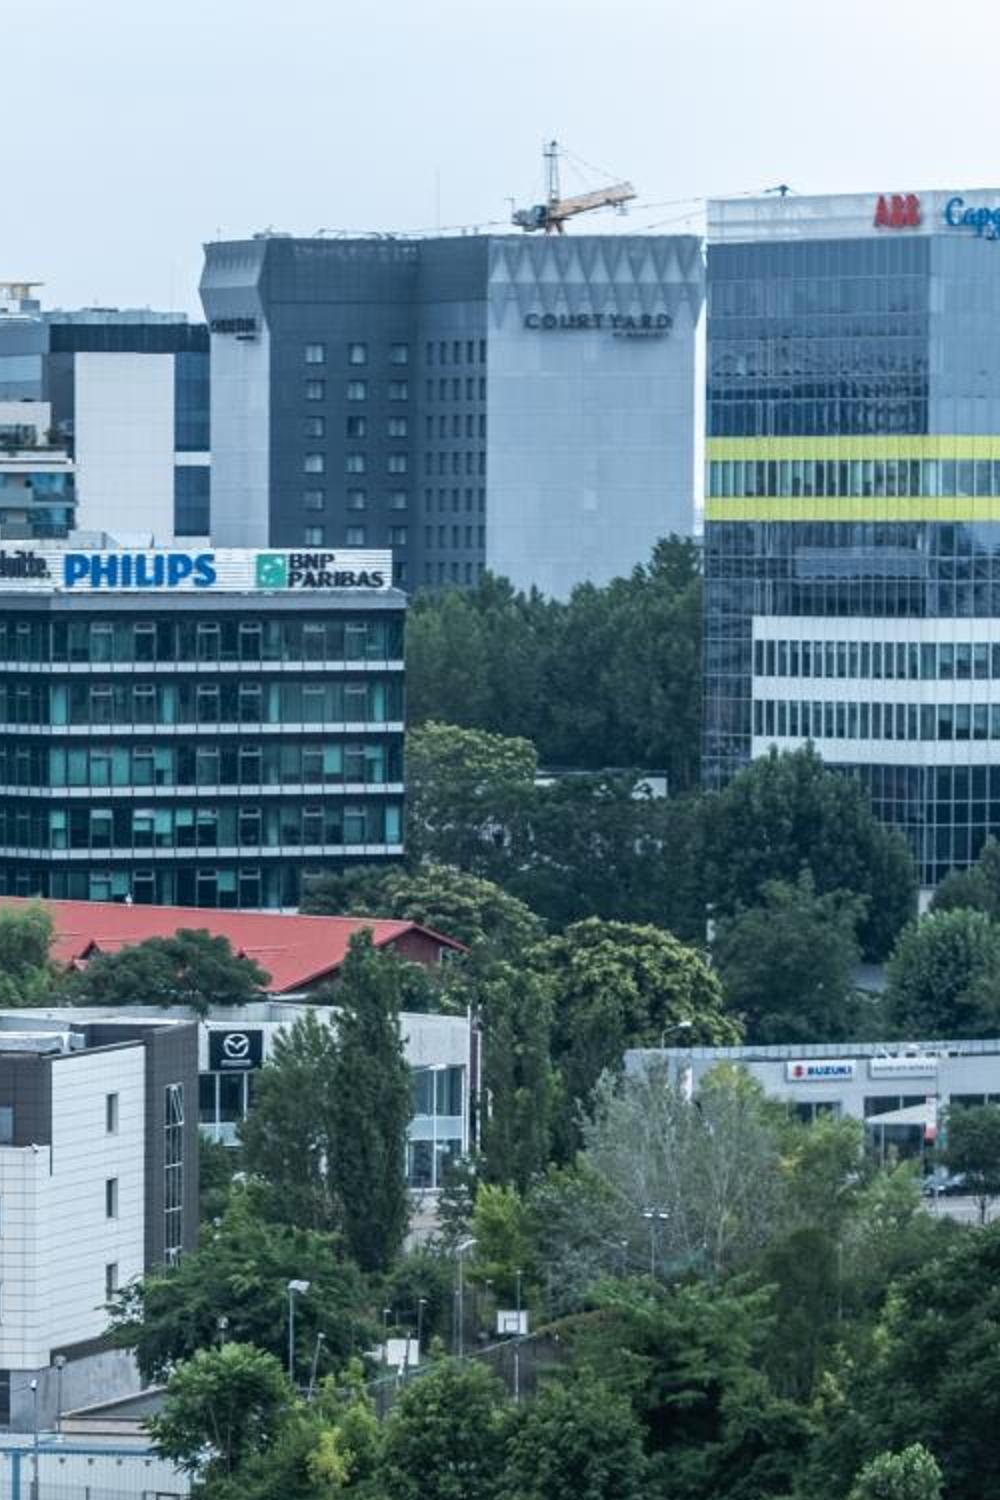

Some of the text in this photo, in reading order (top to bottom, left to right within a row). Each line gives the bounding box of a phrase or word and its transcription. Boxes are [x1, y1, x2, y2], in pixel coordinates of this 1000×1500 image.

[873, 193, 921, 228] ABB
[524, 313, 673, 329] COURTYARD
[289, 553, 335, 569] BNP
[64, 553, 216, 587] PHILIPS
[288, 571, 384, 588] PARIBAS
[807, 1065, 852, 1075] SUZUKI
